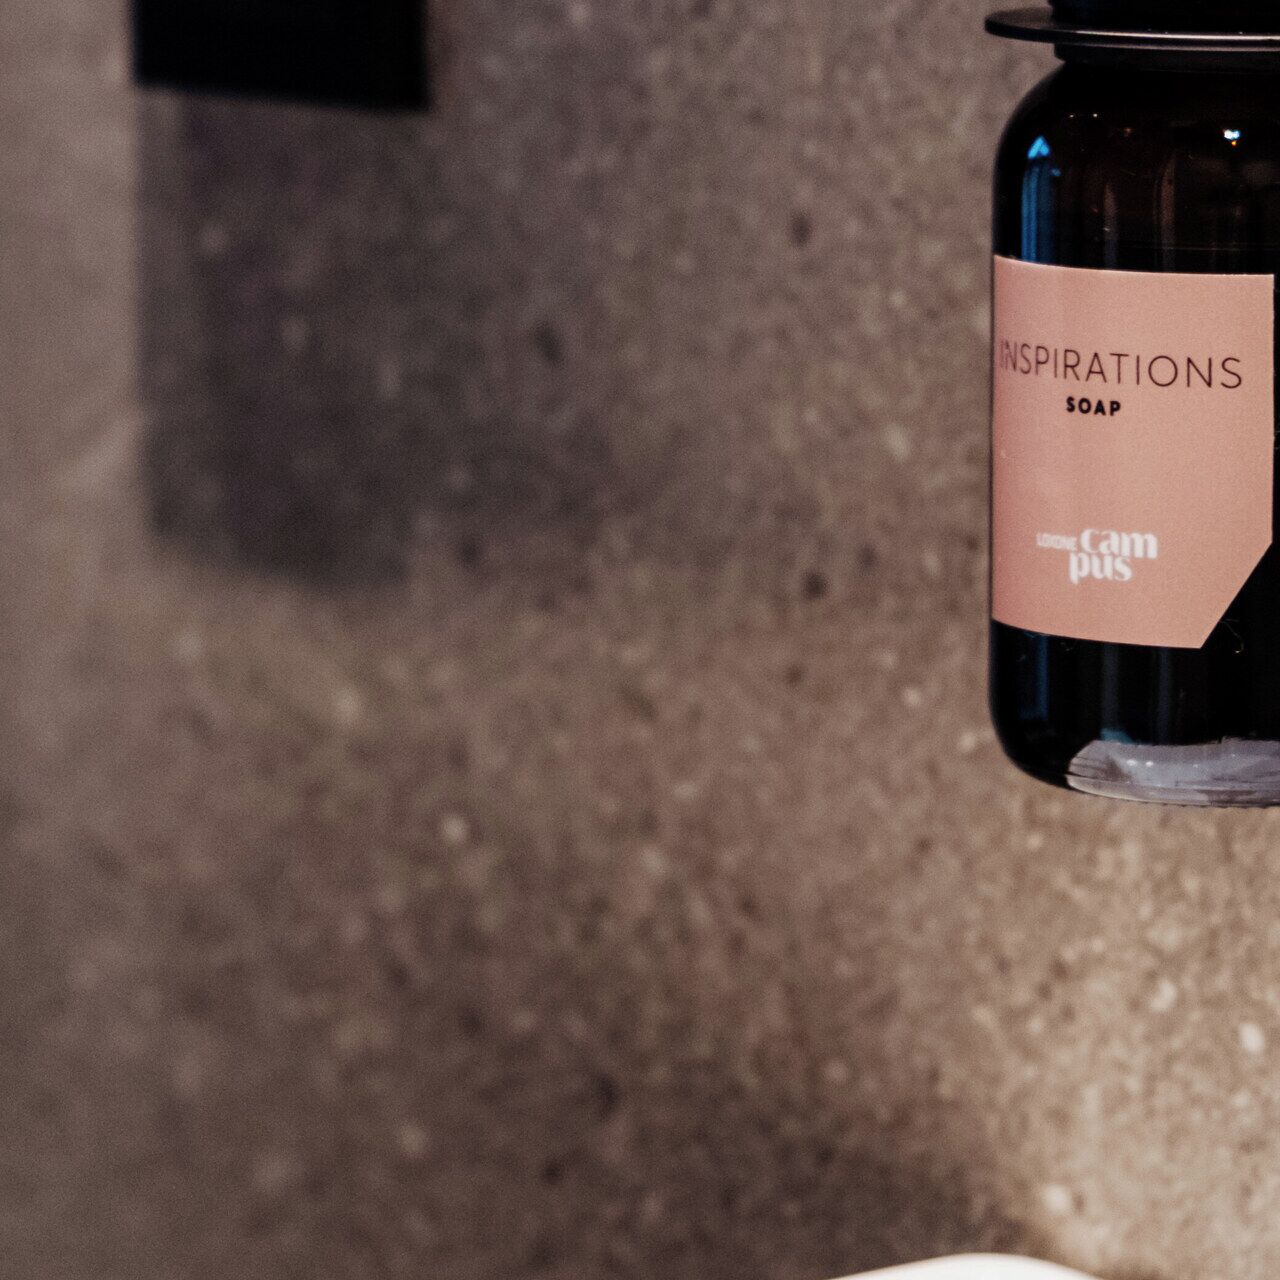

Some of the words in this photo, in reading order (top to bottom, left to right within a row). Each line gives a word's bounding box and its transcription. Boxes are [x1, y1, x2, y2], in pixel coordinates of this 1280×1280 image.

[1066, 396, 1121, 416] SOAP
[1080, 528, 1158, 560] cam
[1069, 552, 1133, 585] pus
